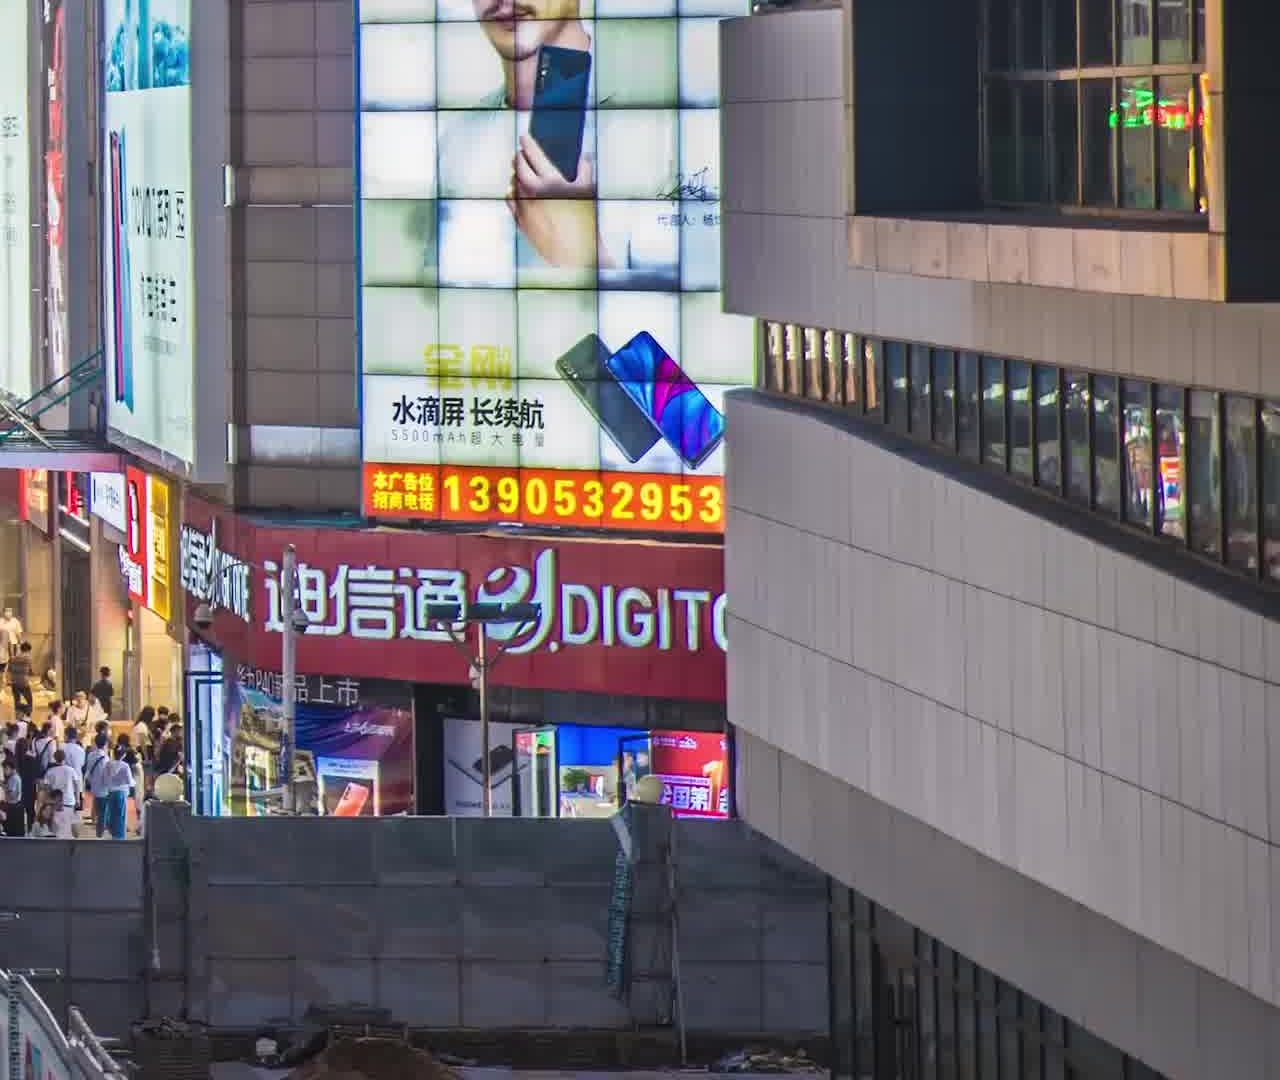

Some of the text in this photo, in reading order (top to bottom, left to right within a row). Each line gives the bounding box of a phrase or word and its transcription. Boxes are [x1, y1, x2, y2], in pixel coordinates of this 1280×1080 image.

[423, 342, 513, 393] 金刚
[391, 394, 546, 430] 水滴屏 长续航
[372, 471, 436, 494] 本广告位
[263, 559, 467, 643] 迪信通
